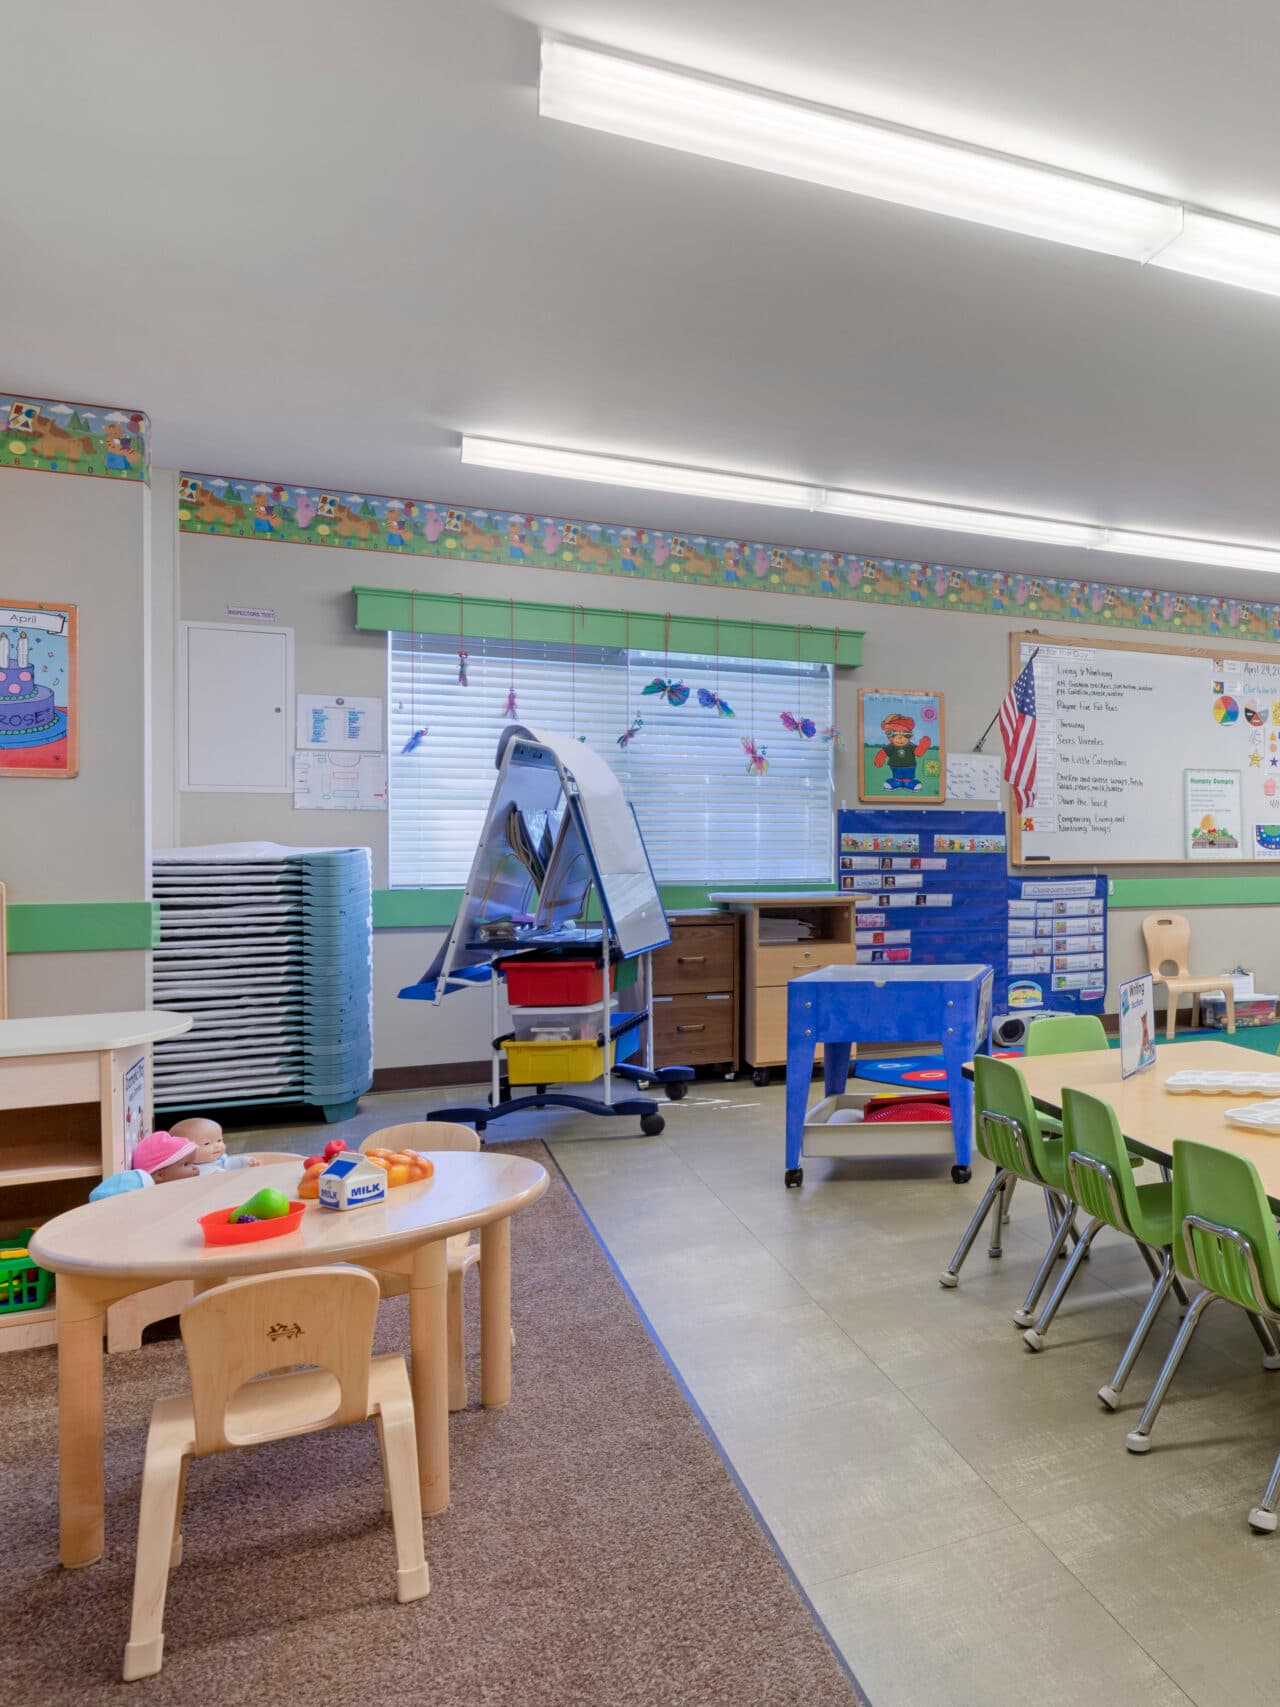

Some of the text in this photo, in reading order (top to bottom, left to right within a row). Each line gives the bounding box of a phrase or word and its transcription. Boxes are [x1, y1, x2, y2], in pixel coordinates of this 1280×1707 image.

[10, 614, 37, 624] April
[1057, 664, 1078, 677] Living
[320, 1187, 338, 1200] MILK
[352, 1182, 380, 1198] MILK
